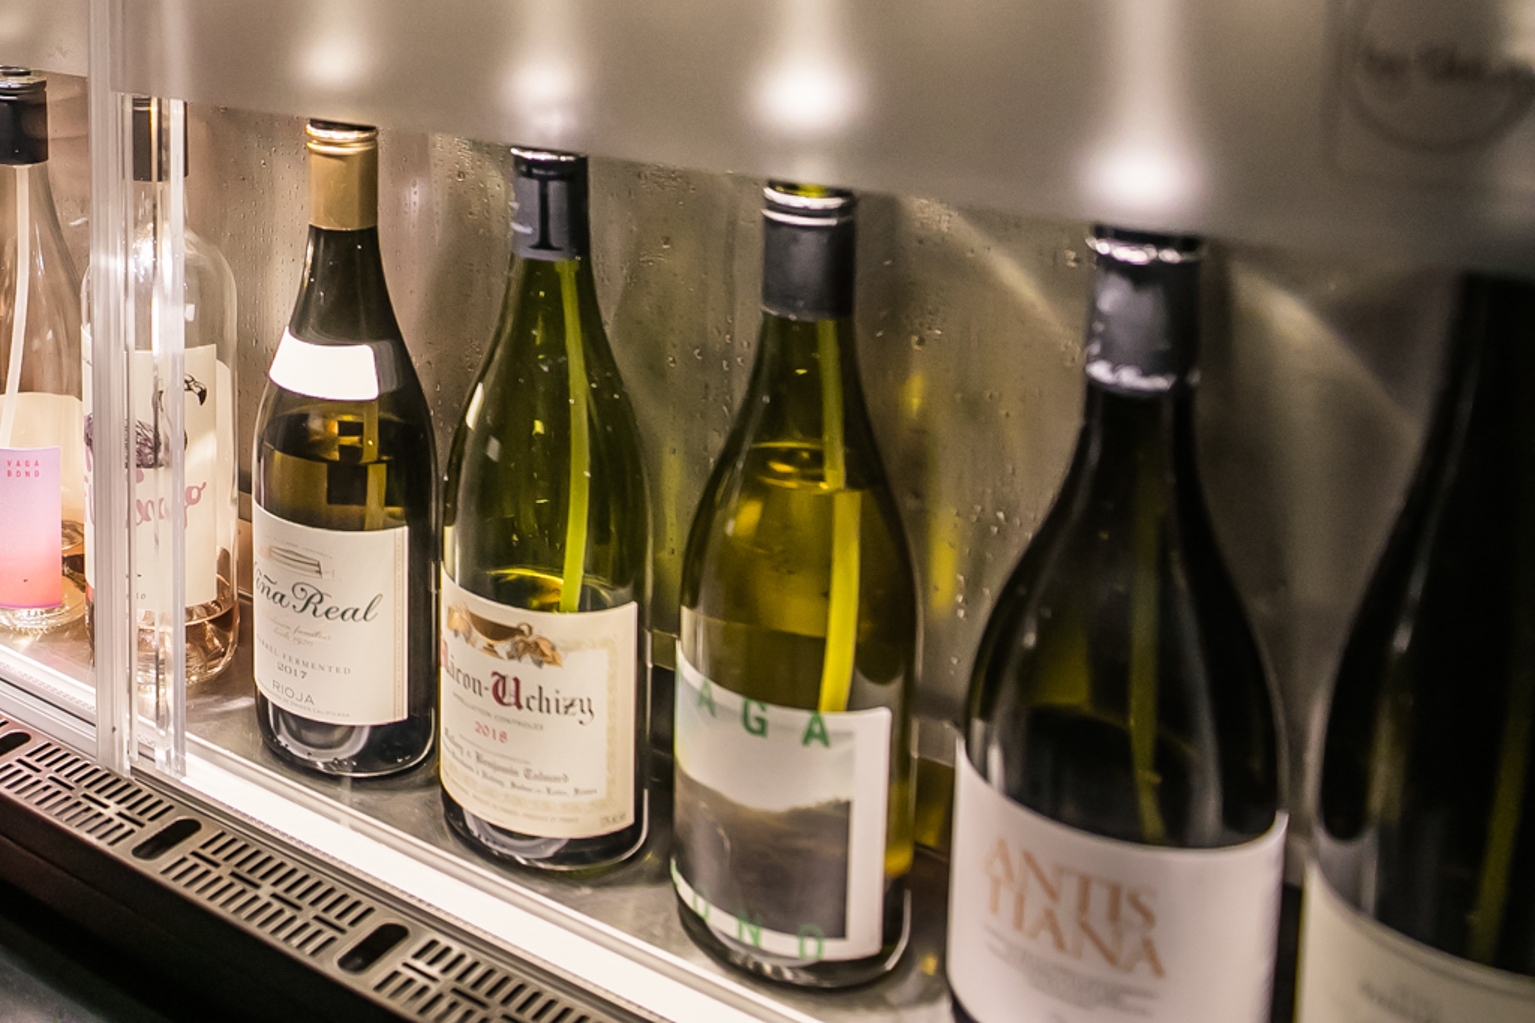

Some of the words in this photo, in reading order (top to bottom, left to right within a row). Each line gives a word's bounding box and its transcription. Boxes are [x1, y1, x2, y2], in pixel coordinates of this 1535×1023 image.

[7, 459, 40, 467] VAGA
[7, 470, 40, 478] BOND
[255, 564, 290, 609] iña
[291, 581, 383, 622] Real
[277, 661, 308, 680] 2017
[282, 653, 352, 675] FERMENTED
[272, 679, 315, 705] RIOJA
[675, 665, 829, 747] AGA
[475, 721, 508, 744] 2018
[985, 837, 1157, 933] ANTIS
